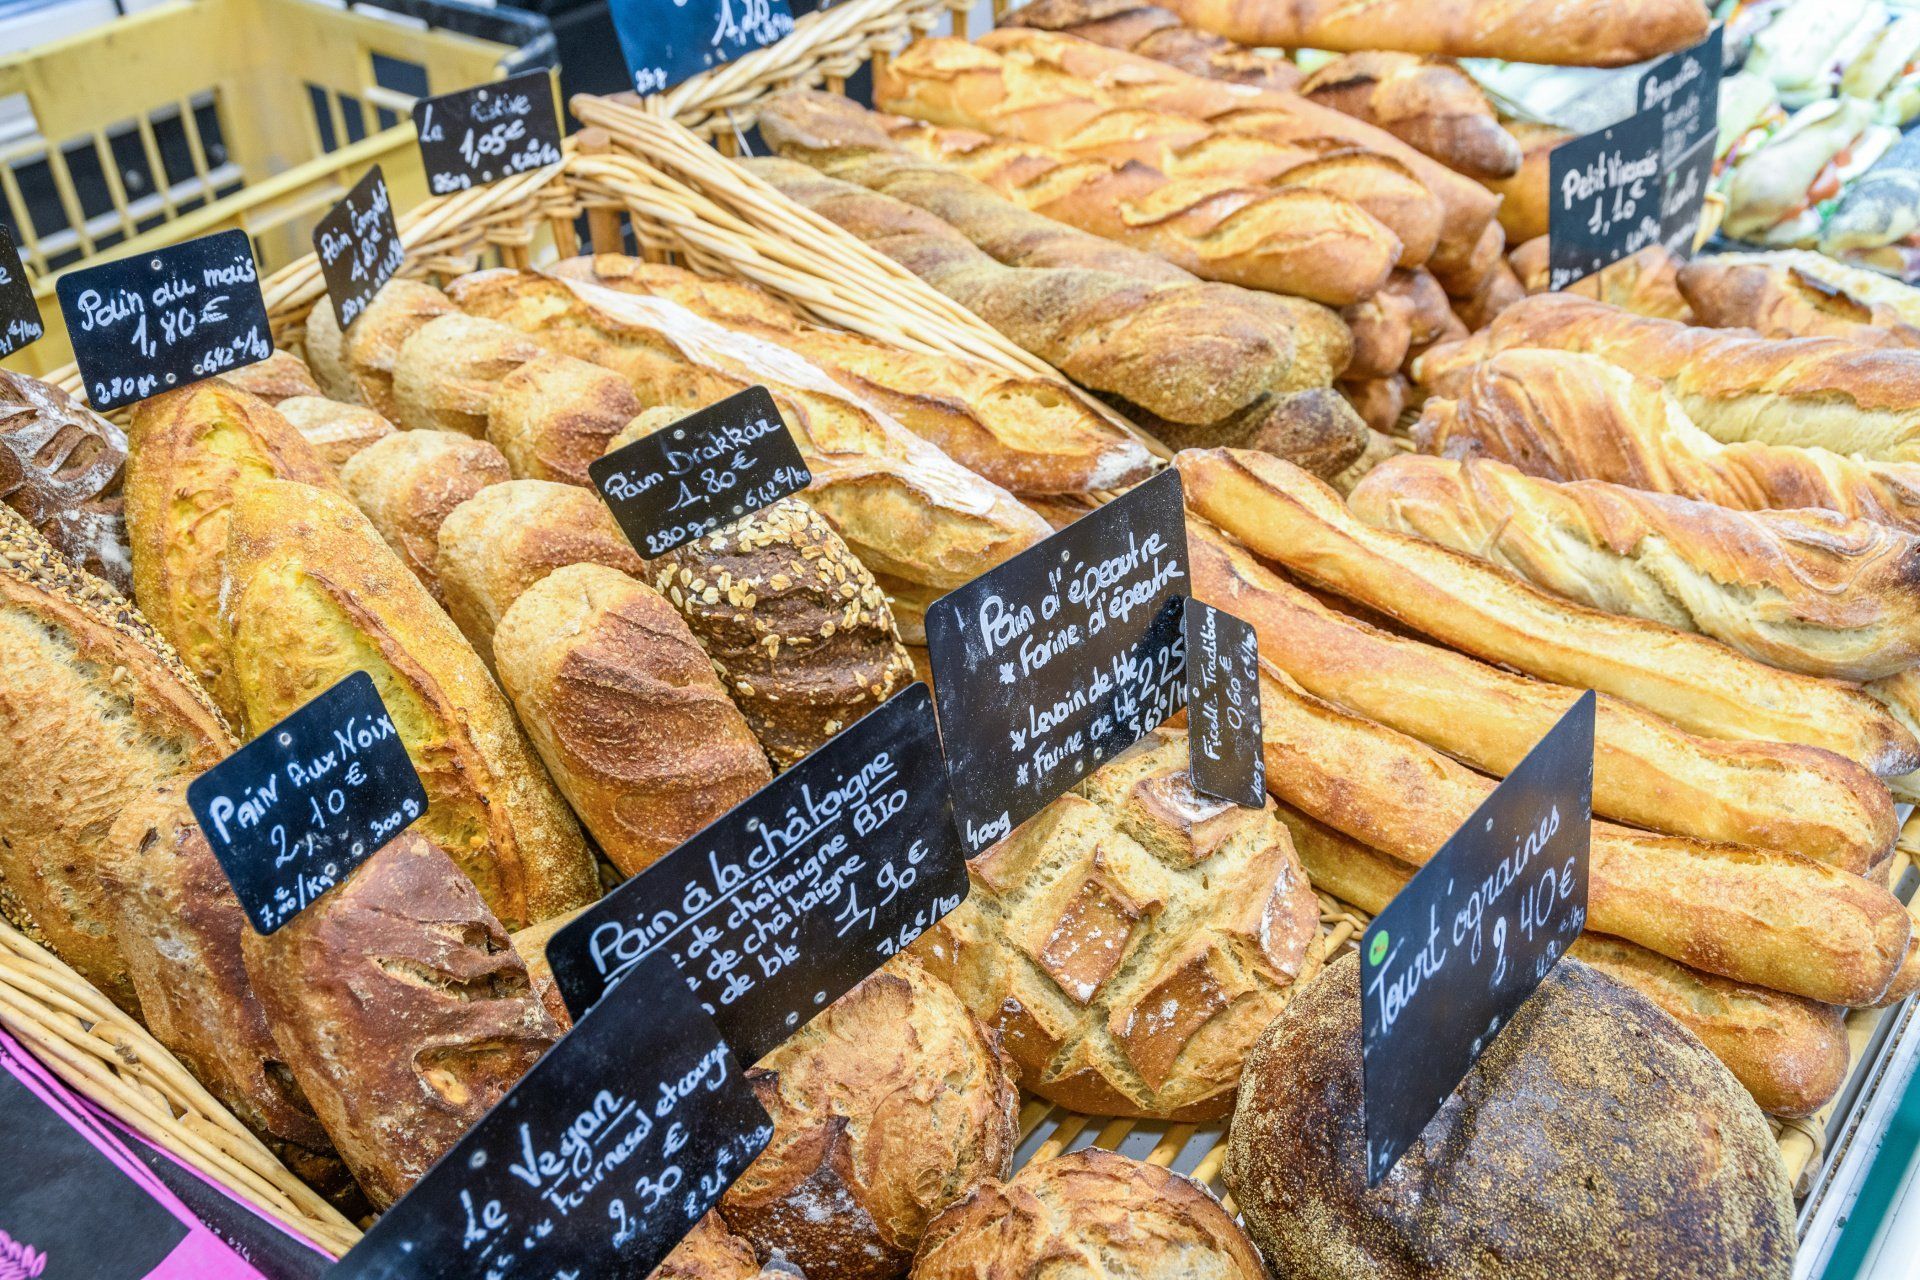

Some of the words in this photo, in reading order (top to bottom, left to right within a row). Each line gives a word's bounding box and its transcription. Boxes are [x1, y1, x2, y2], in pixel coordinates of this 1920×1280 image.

[1561, 152, 1606, 210] Petit
[77, 289, 144, 331] Pain
[152, 278, 196, 306] au
[604, 470, 664, 502] Pain
[667, 418, 781, 476] Drakkar
[979, 594, 1036, 656] Pain
[1019, 623, 1079, 678] Farine
[1029, 690, 1087, 741] Levain
[1088, 666, 1113, 704] de
[1113, 642, 1139, 687] blé
[1033, 729, 1084, 779] Farine
[1114, 682, 1140, 722] blé
[589, 910, 678, 975] Pain
[708, 850, 745, 894] la
[747, 752, 896, 870] châtaigne
[966, 810, 1011, 851] 400g
[688, 924, 724, 959] de
[727, 833, 848, 930] châtaigne
[853, 789, 908, 837] BIO
[706, 948, 743, 980] de
[743, 854, 867, 954] châtaigne
[720, 972, 756, 1005] de
[757, 926, 800, 978] blé
[460, 1188, 509, 1250] Le
[508, 1089, 625, 1188] Vegan
